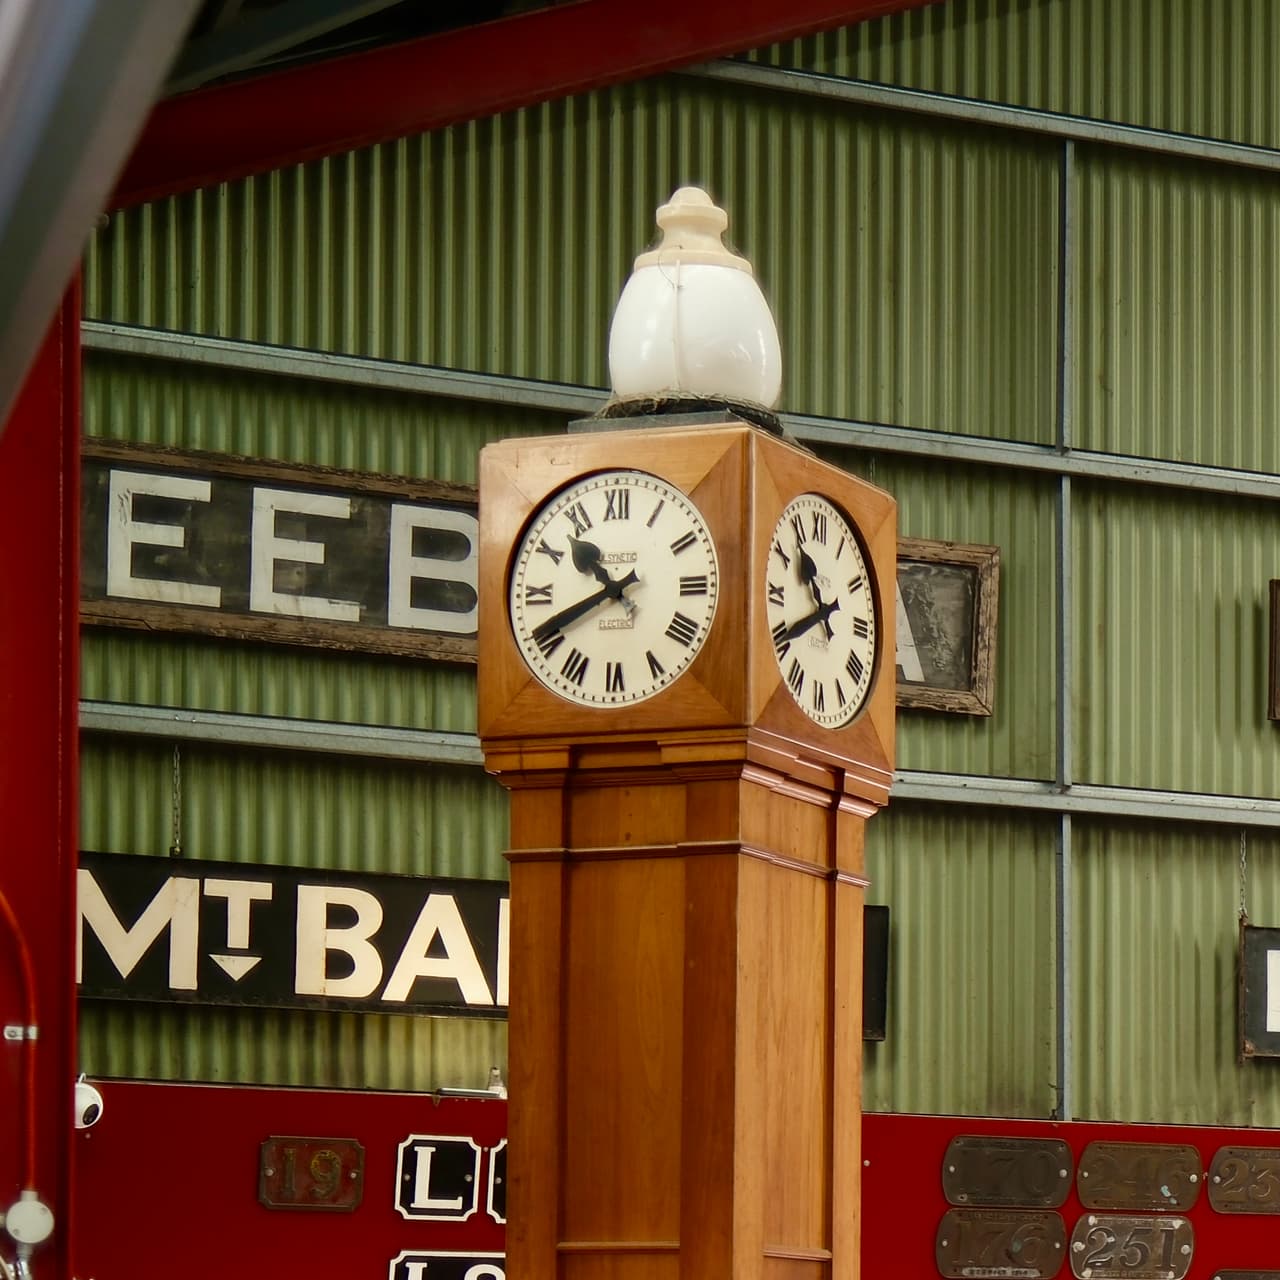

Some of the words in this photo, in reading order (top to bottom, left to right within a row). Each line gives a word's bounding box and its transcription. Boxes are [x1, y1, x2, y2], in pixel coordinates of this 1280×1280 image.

[295, 884, 510, 1006] BA
[281, 1146, 341, 1200] 19
[410, 1145, 464, 1210] L
[1081, 1226, 1177, 1269] 251
